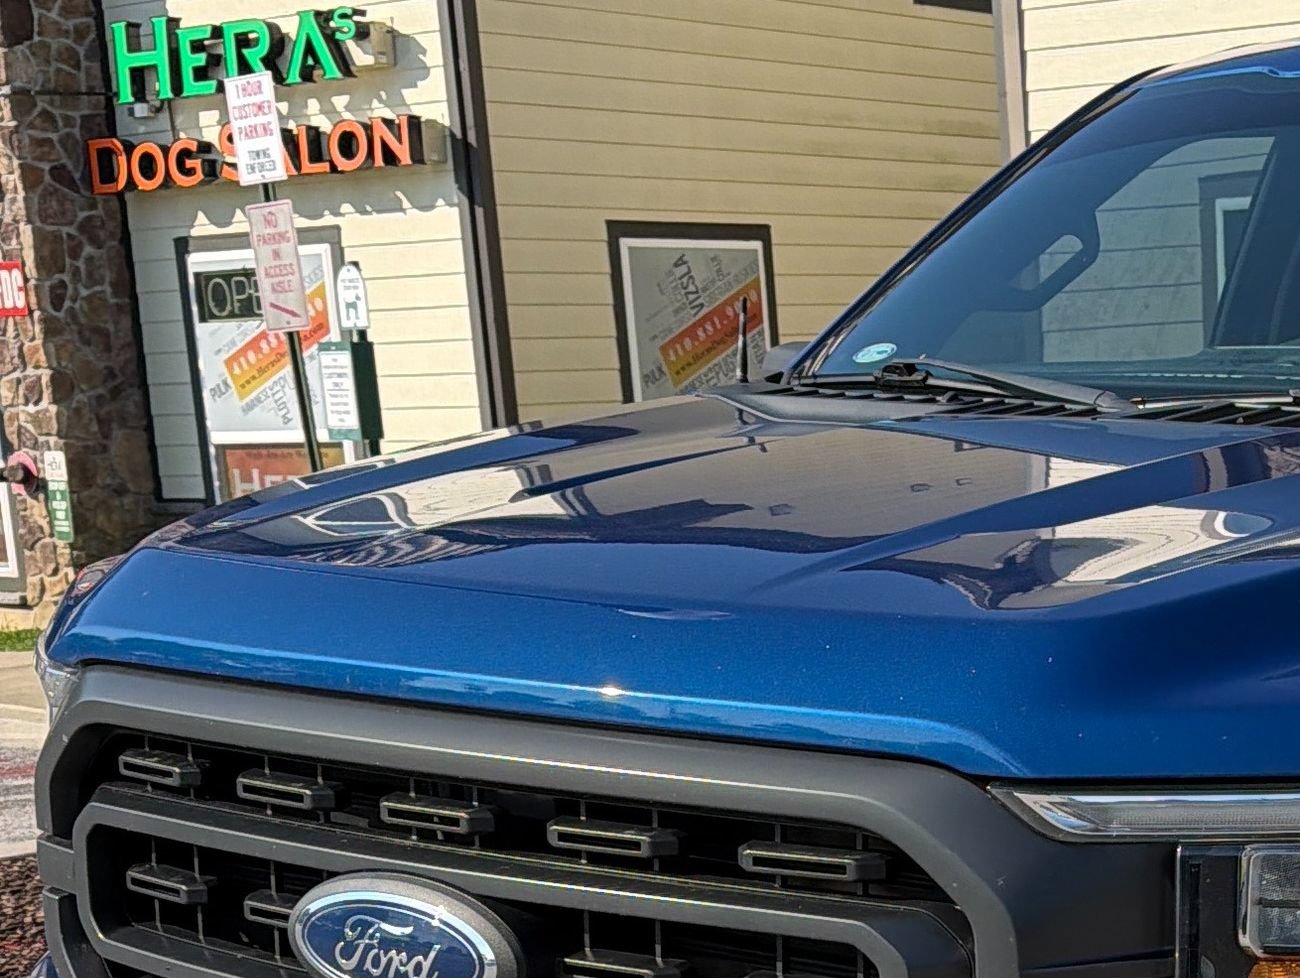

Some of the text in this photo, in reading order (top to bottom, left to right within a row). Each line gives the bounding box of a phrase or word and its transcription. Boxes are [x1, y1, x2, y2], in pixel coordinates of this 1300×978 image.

[241, 81, 263, 97] HOUR
[232, 100, 272, 120] CUSTOMER
[238, 121, 274, 141] PARKING
[87, 136, 204, 194] DOG
[245, 160, 277, 175] ENFORCED
[263, 211, 278, 228] NO
[256, 231, 290, 245] PARKING
[272, 249, 282, 261] IN
[264, 263, 295, 278] ACCESS
[673, 253, 705, 317] VIZSLA
[208, 277, 263, 316] OPE
